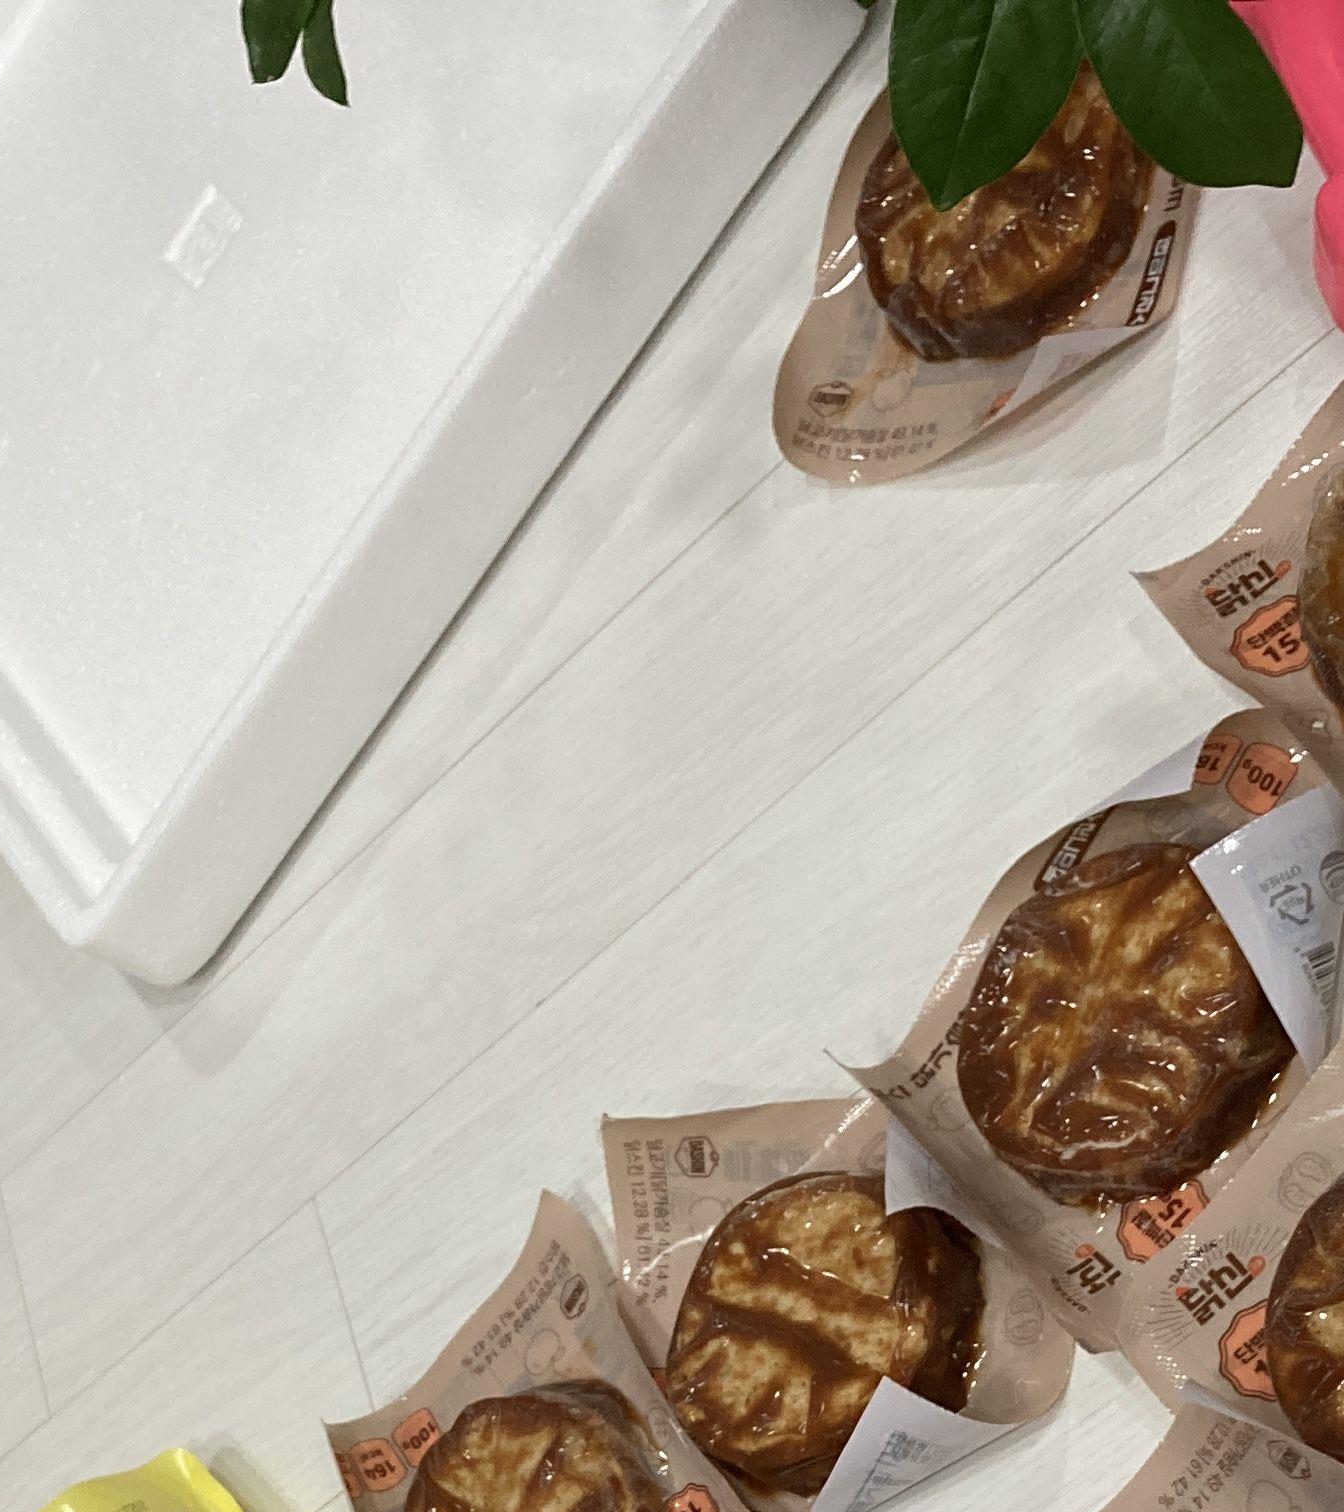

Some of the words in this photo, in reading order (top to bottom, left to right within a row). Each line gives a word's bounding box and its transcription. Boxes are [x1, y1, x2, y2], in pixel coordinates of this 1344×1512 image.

[1204, 559, 1278, 619] 닭신
[1241, 757, 1283, 797] 100g
[1176, 1250, 1254, 1326] 닭신
[399, 1420, 438, 1455] 100g
[362, 1457, 397, 1483] 164
